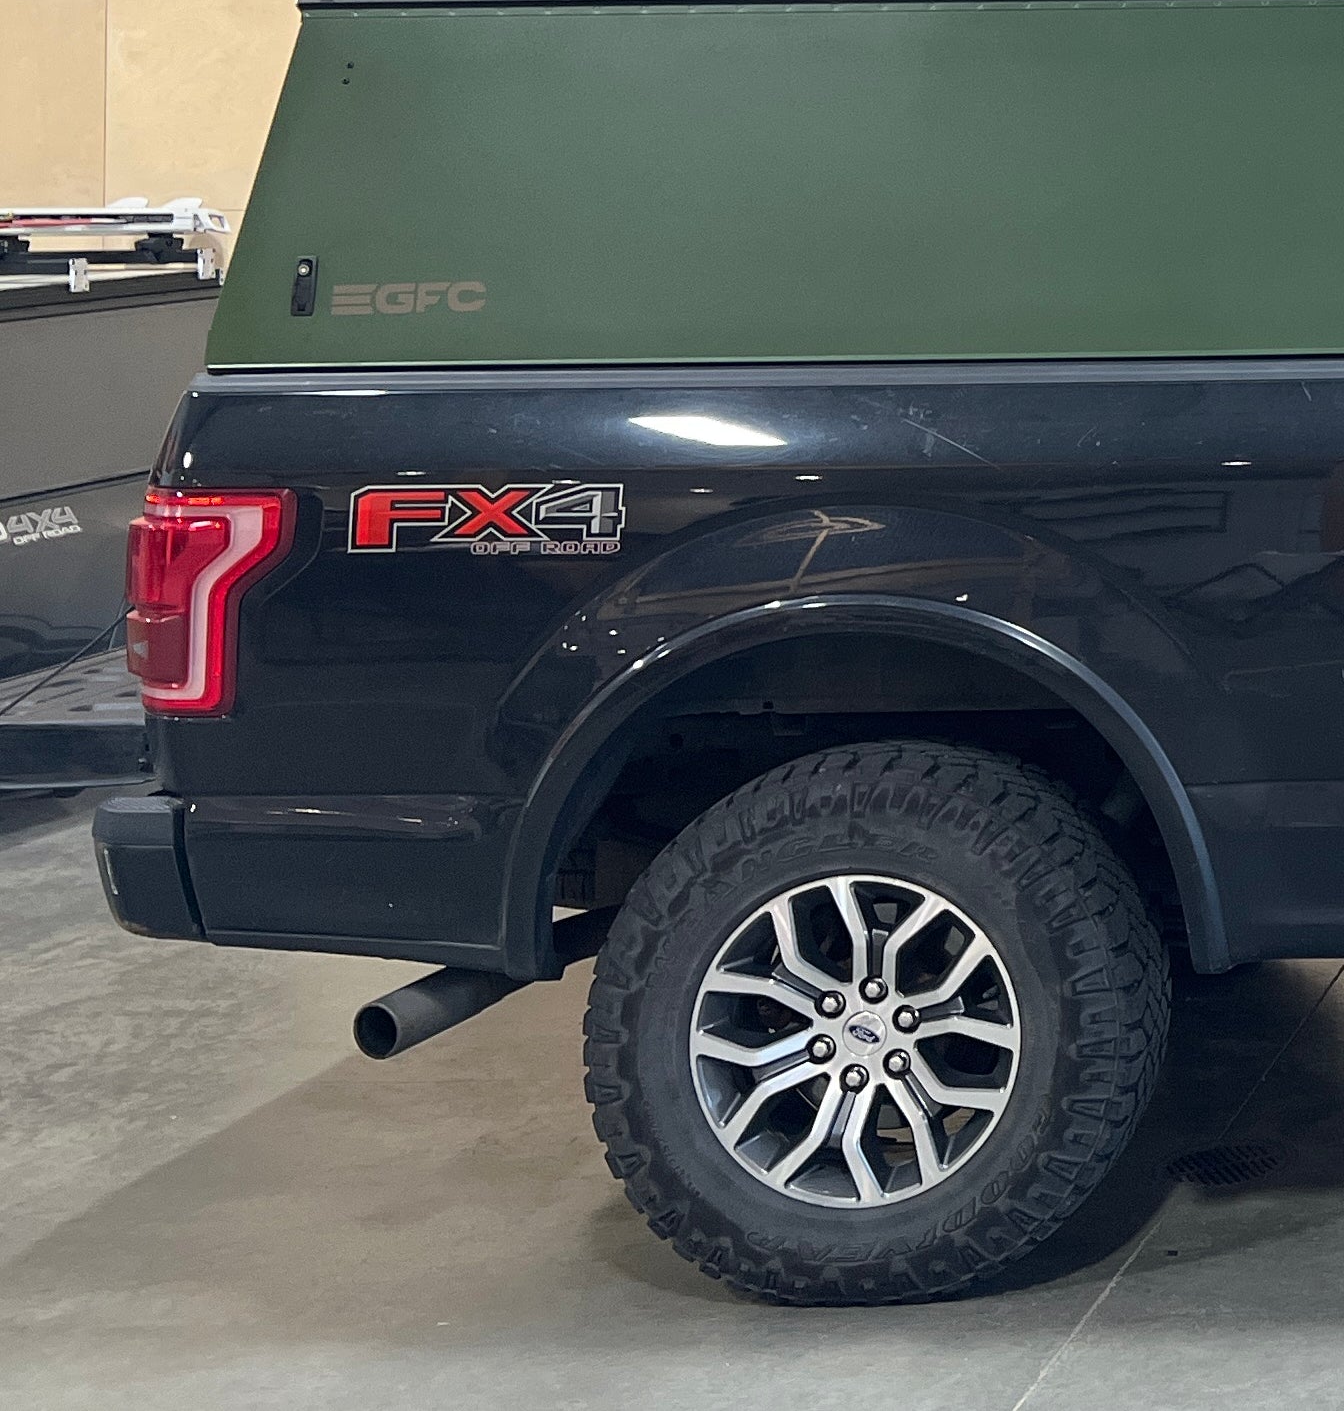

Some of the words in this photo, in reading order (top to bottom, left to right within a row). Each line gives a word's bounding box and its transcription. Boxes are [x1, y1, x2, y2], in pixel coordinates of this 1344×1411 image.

[6, 505, 80, 535] 4X4
[347, 483, 626, 554] FX4
[12, 531, 41, 546] OFF
[42, 523, 84, 540] ROAD
[470, 540, 532, 555] OFF
[540, 540, 622, 555] ROAD
